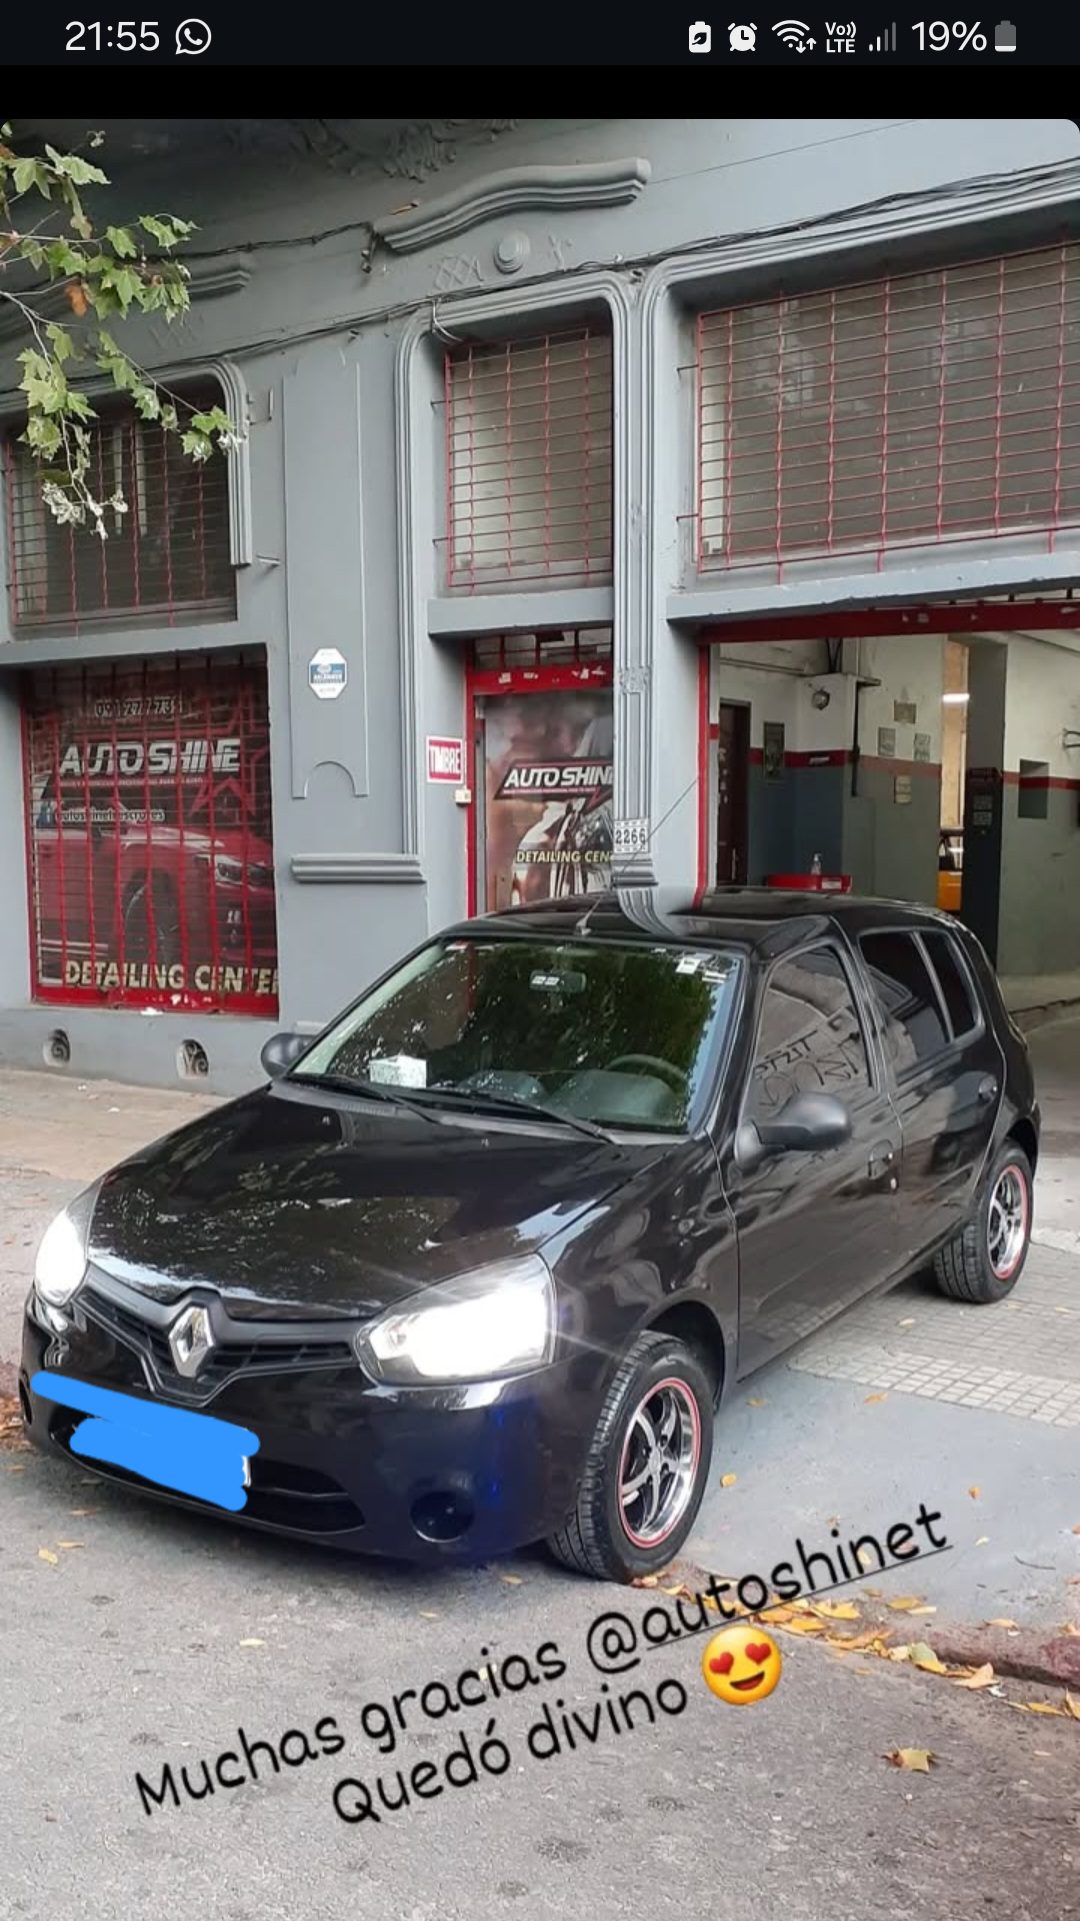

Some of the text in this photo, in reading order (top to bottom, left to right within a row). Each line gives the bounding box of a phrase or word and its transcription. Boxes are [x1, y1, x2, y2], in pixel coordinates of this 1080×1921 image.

[428, 745, 461, 774] TIMBRE
[615, 827, 646, 845] 2266
[516, 850, 613, 863] DETAILING CEN
[64, 959, 186, 991] DETAILING
